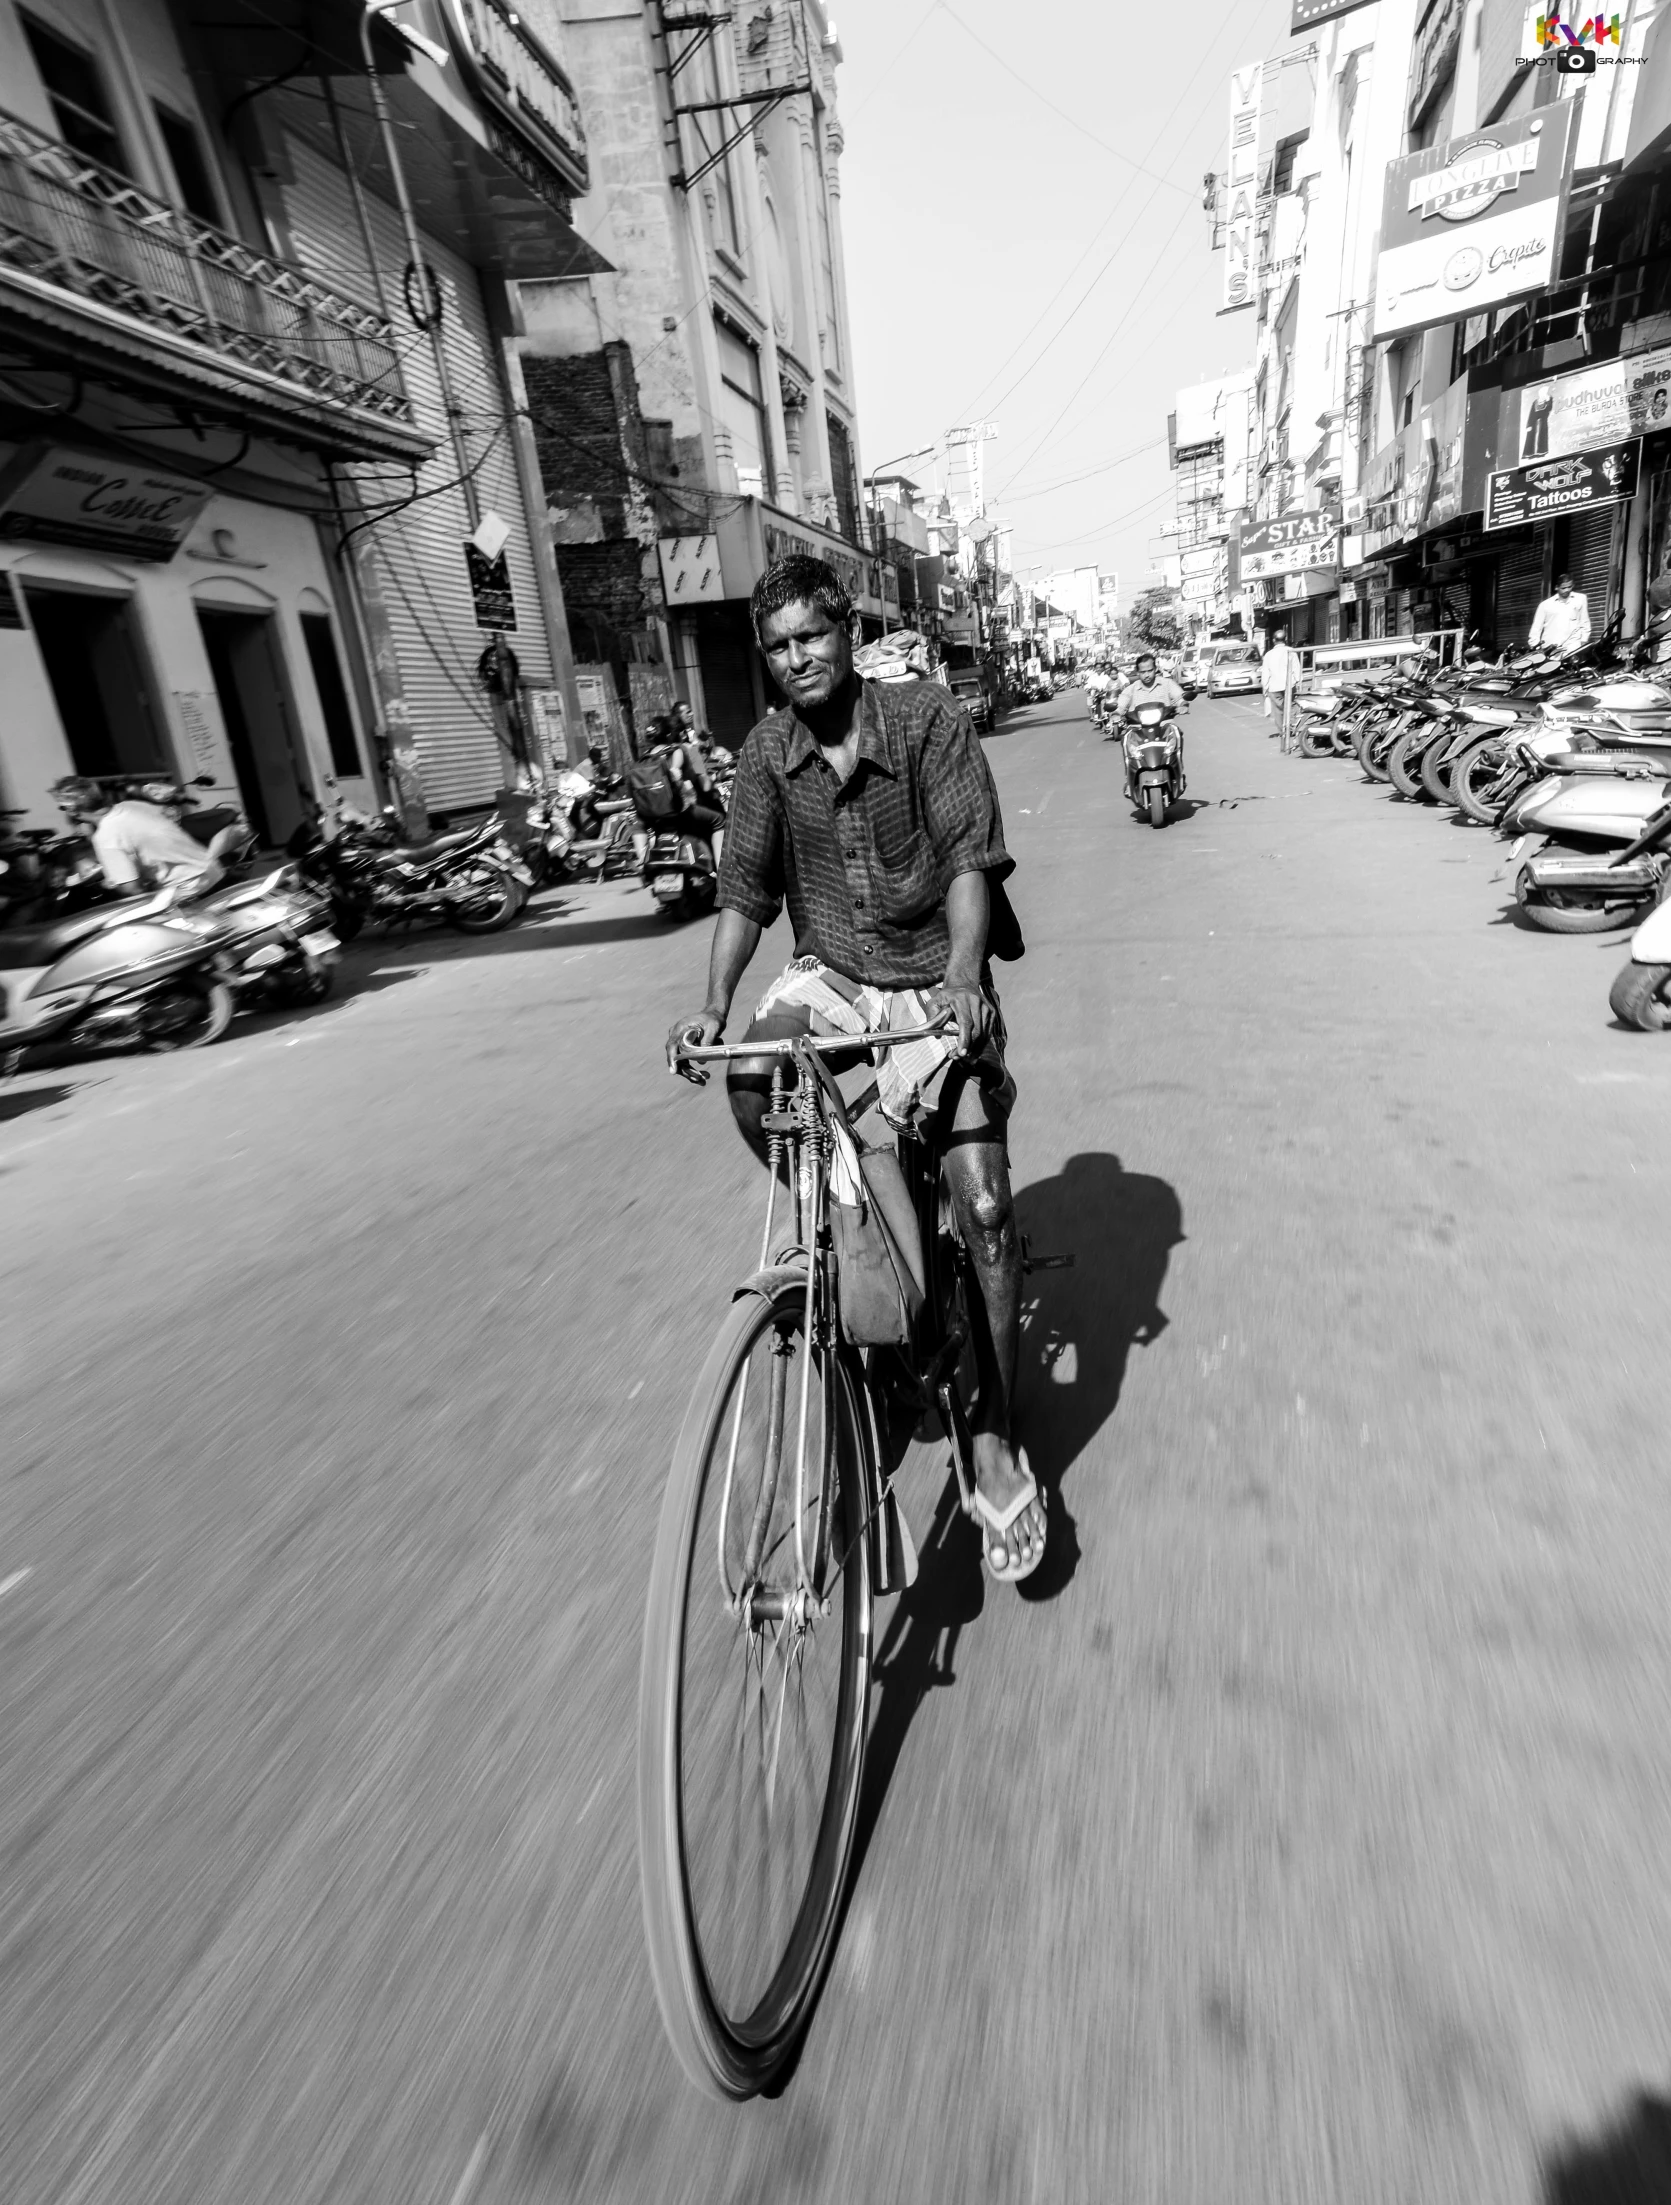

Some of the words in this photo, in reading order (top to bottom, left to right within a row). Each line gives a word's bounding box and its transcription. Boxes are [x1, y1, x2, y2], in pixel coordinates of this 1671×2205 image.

[1228, 64, 1261, 304] VELAN'S
[1434, 176, 1506, 210] PIZZA
[1576, 406, 1589, 418] THE
[1620, 390, 1643, 406] STORE
[1525, 457, 1592, 482] DARK
[1533, 469, 1593, 491] WOLF
[1527, 486, 1593, 510] Tattoos
[1241, 526, 1267, 548] Super
[1267, 513, 1333, 543] STAR
[1274, 540, 1291, 549] GIFT
